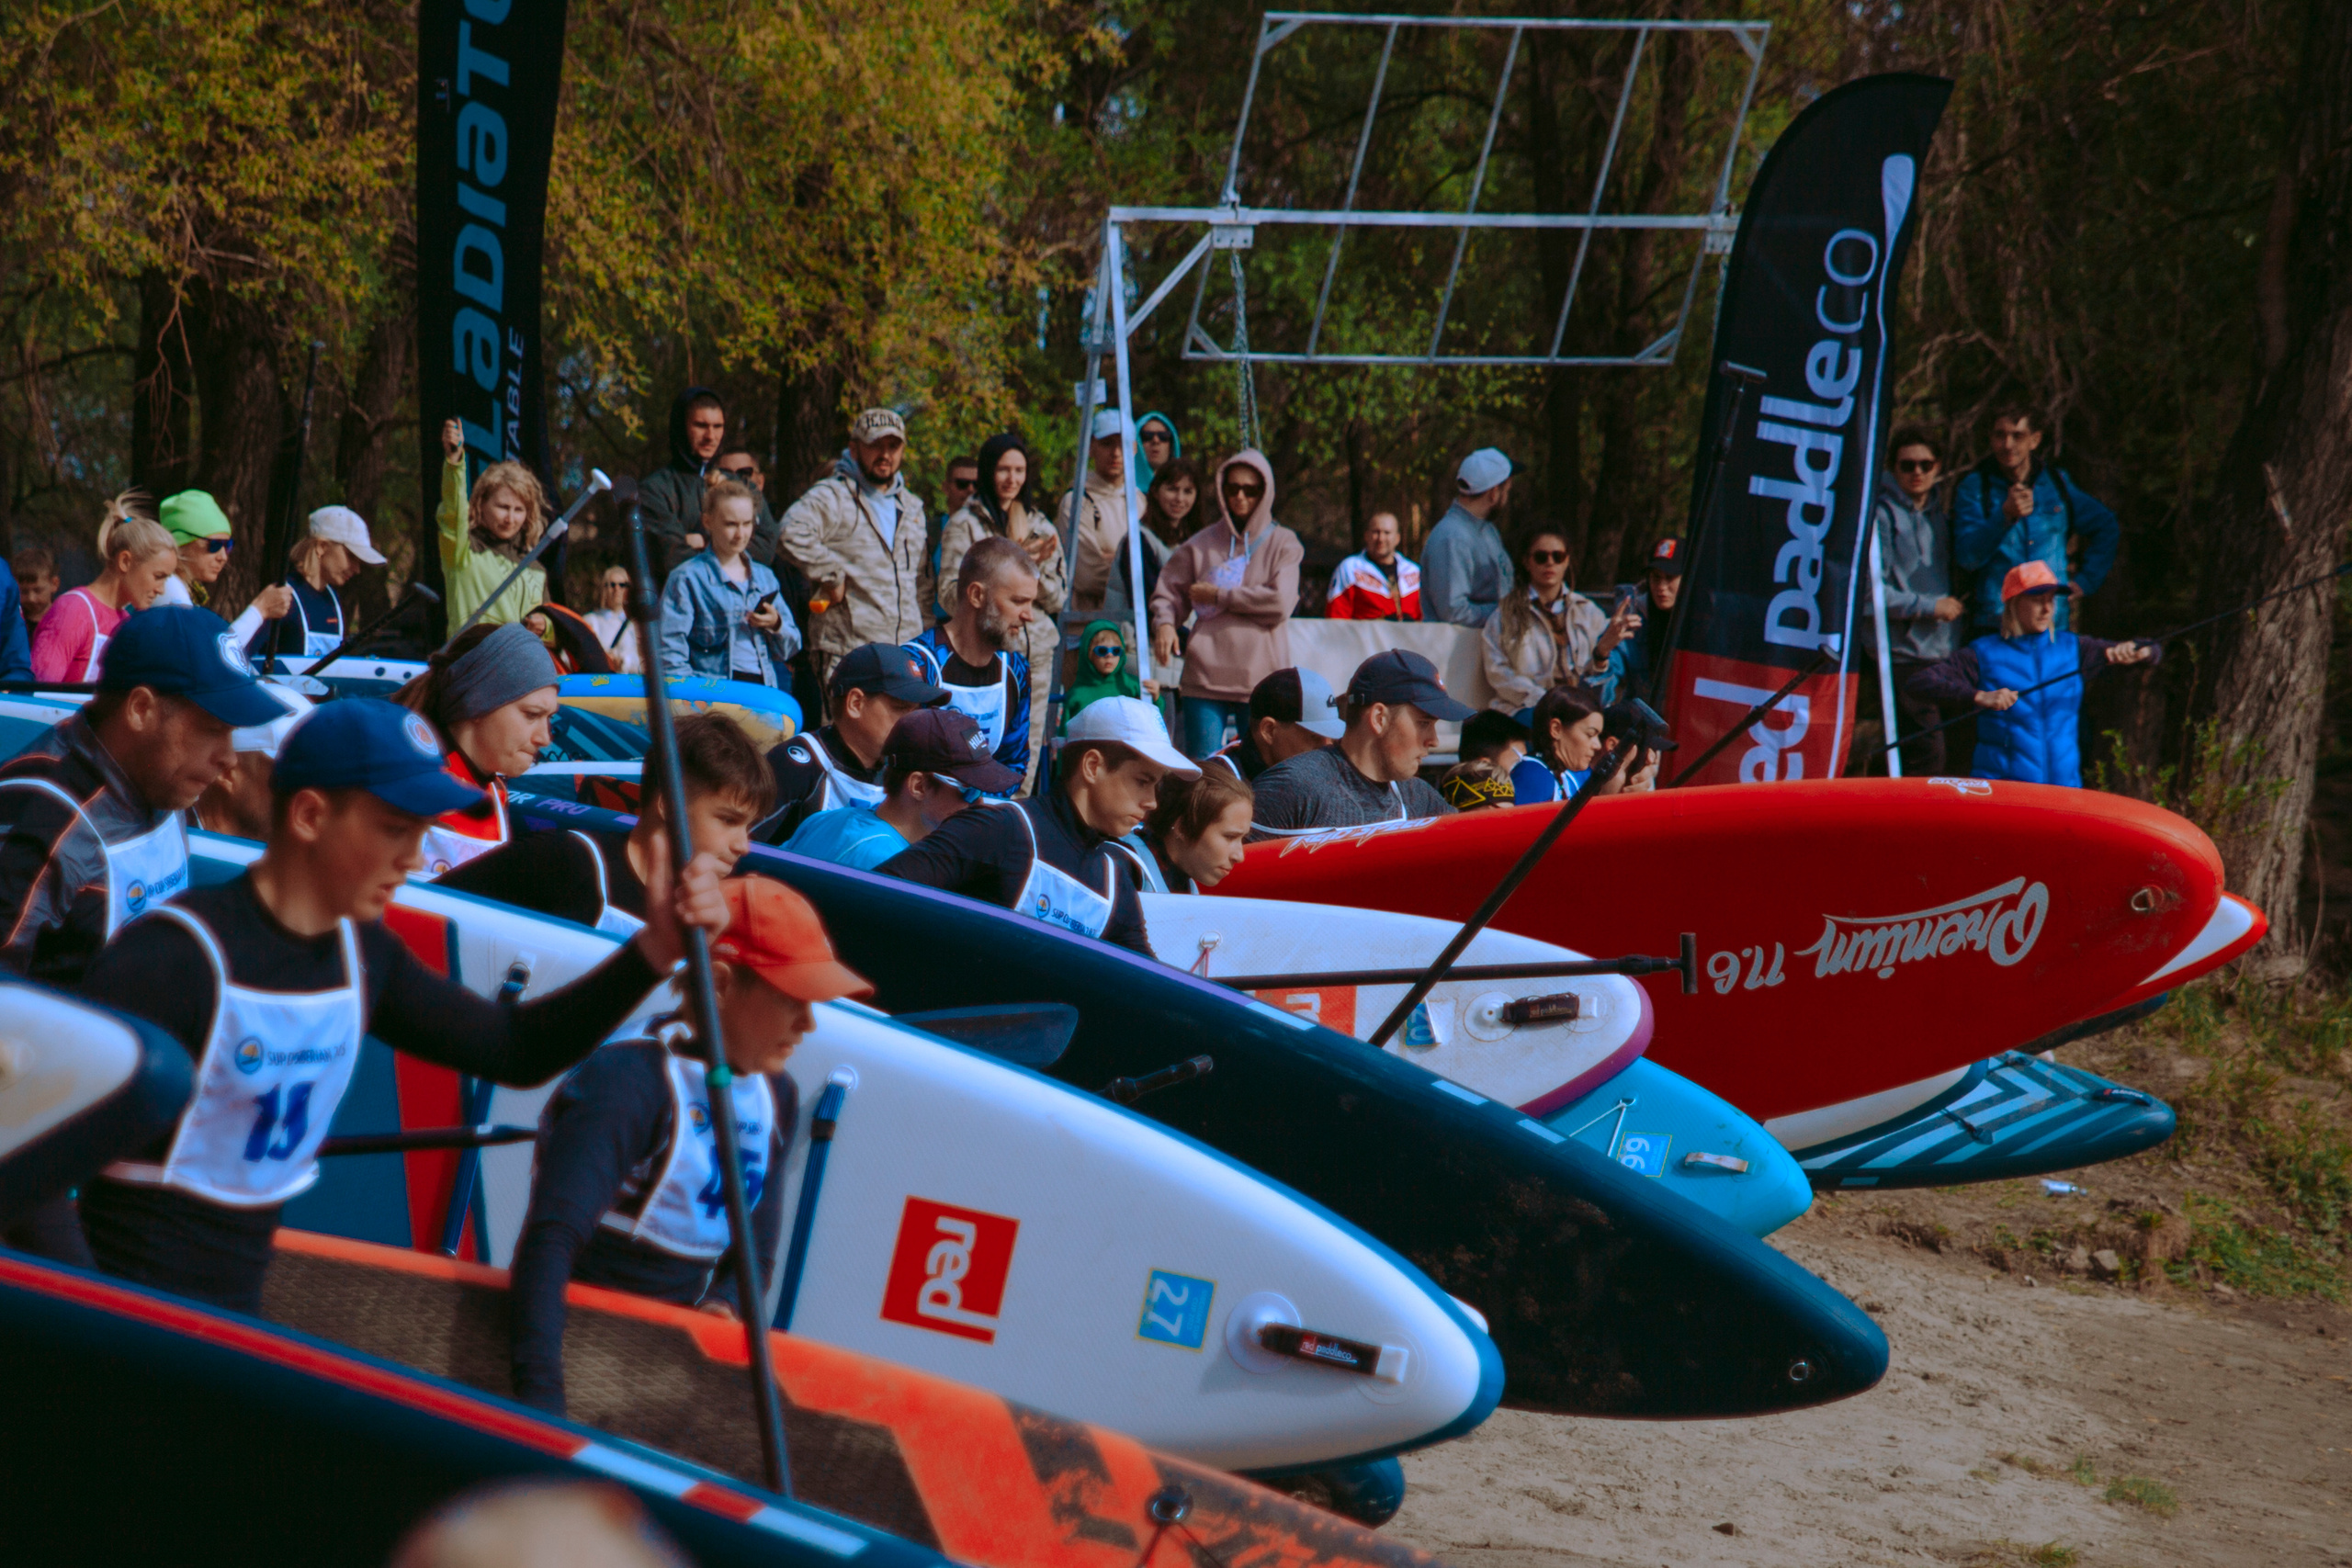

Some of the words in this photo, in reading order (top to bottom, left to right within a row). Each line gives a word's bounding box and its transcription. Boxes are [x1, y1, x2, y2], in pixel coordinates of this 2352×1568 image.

[506, 325, 524, 463] TABLE
[1748, 228, 1879, 651] paddleco
[1694, 677, 1810, 782] ed
[1707, 942, 1786, 995] 11.6
[1793, 875, 2050, 980] Premium
[916, 1214, 1000, 1331] red
[1148, 1277, 1189, 1337] 27
[1301, 1336, 1317, 1351] red
[1315, 1342, 1352, 1359] paddleco
